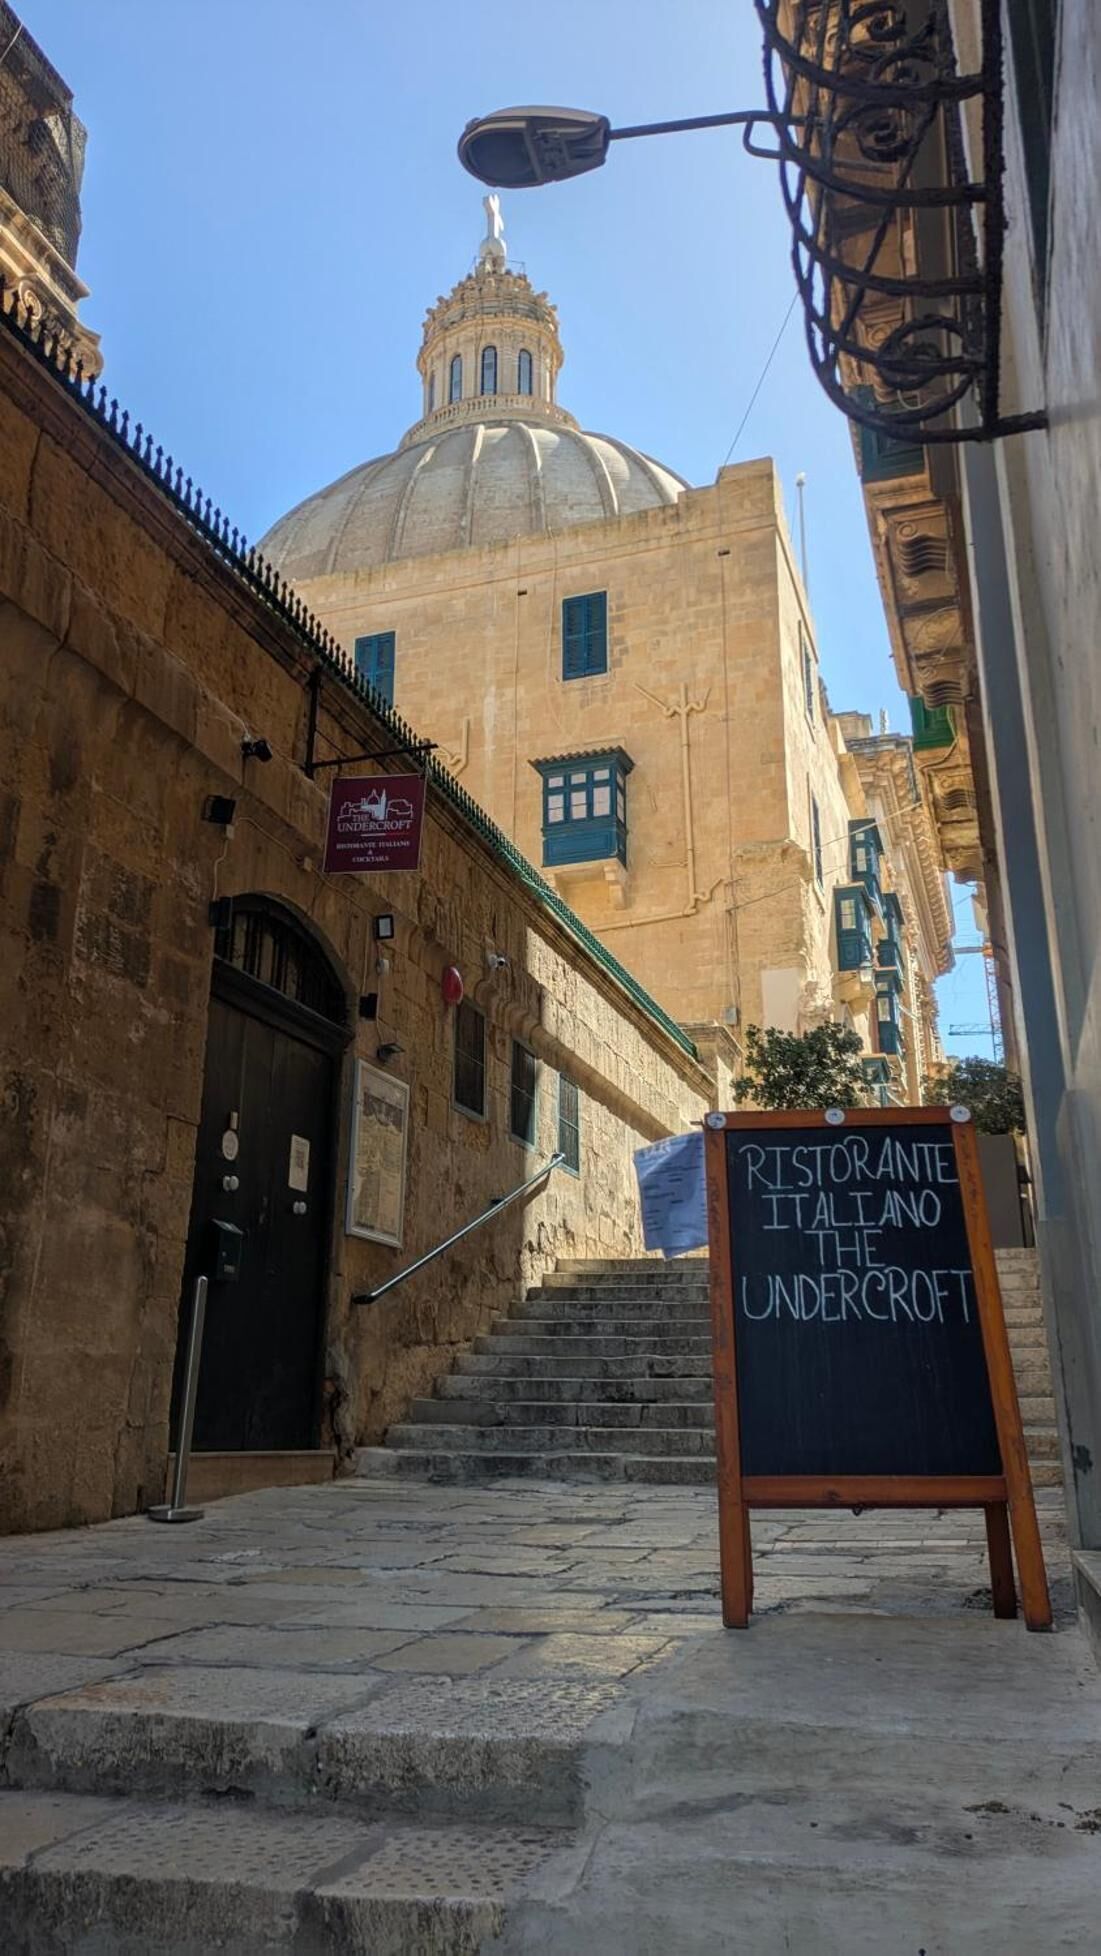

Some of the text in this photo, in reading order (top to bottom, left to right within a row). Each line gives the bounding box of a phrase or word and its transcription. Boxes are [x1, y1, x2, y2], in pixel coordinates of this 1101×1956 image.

[337, 820, 413, 832] UNDERCROFT
[336, 842, 376, 850] RISTORANTE
[739, 1136, 959, 1190] RISTORANTE
[762, 1190, 941, 1229] ITALIANO
[804, 1230, 885, 1267] THE
[742, 1267, 973, 1323] UNDERCROFT
